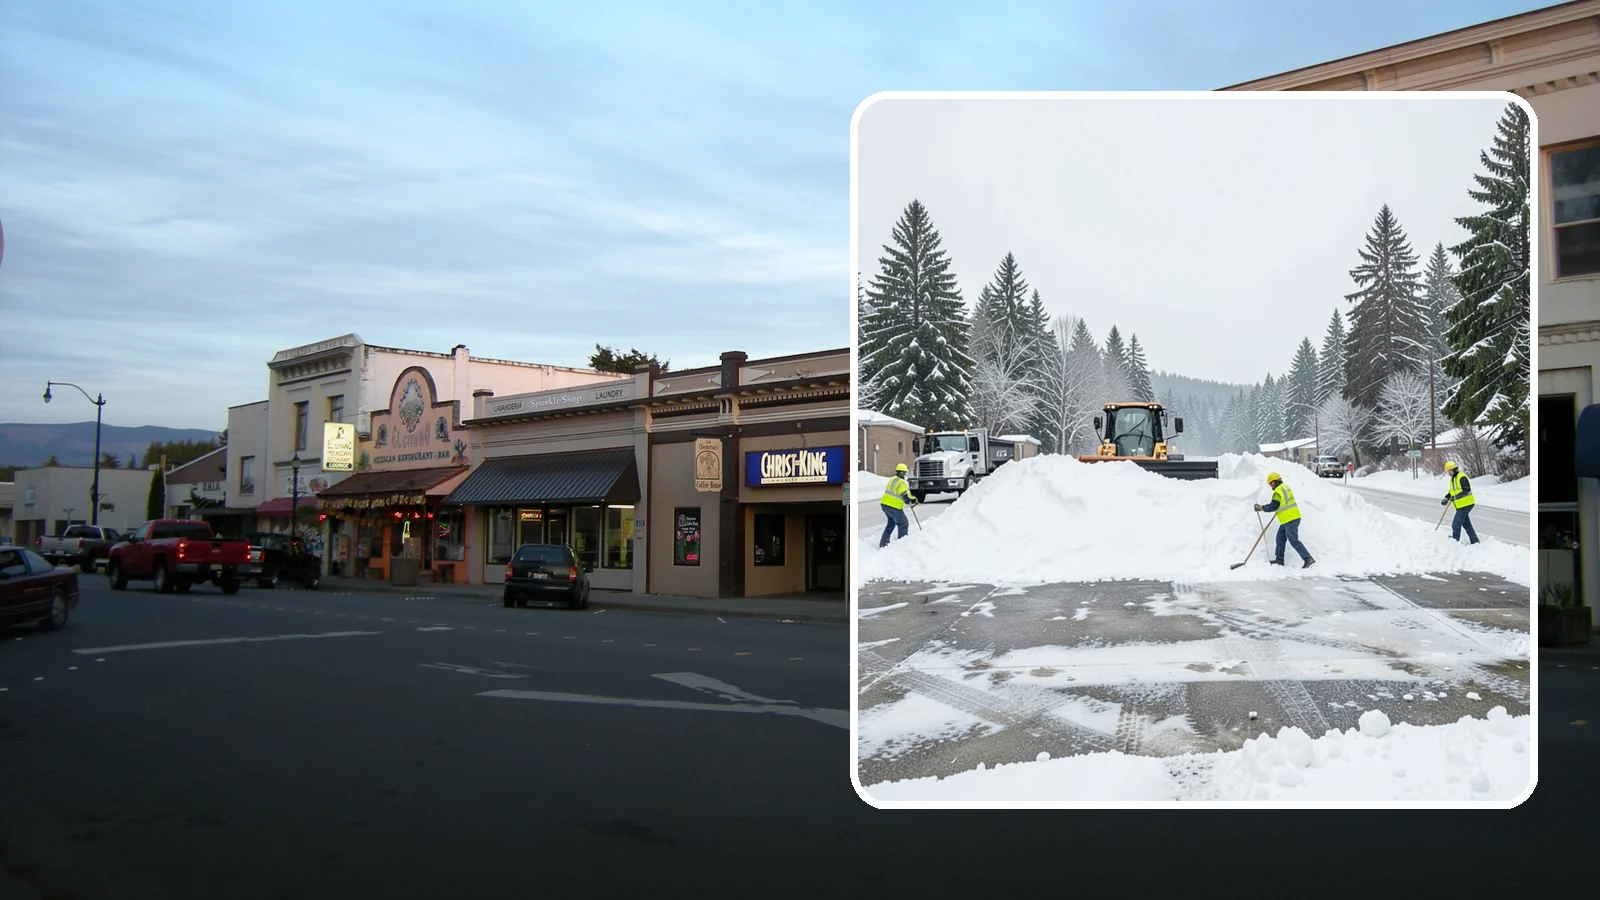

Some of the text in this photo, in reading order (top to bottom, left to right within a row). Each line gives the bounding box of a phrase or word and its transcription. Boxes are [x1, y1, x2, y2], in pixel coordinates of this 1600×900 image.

[595, 389, 624, 400] LAUNDRY
[493, 402, 522, 413] LAVANDERIA
[531, 394, 582, 409] Sparkle Shop
[373, 455, 396, 464] MEXICAN
[397, 451, 433, 462] RESTAURANT
[438, 450, 450, 459] BAR
[761, 450, 827, 478] CHRIST KING
[696, 481, 709, 489] Coffee
